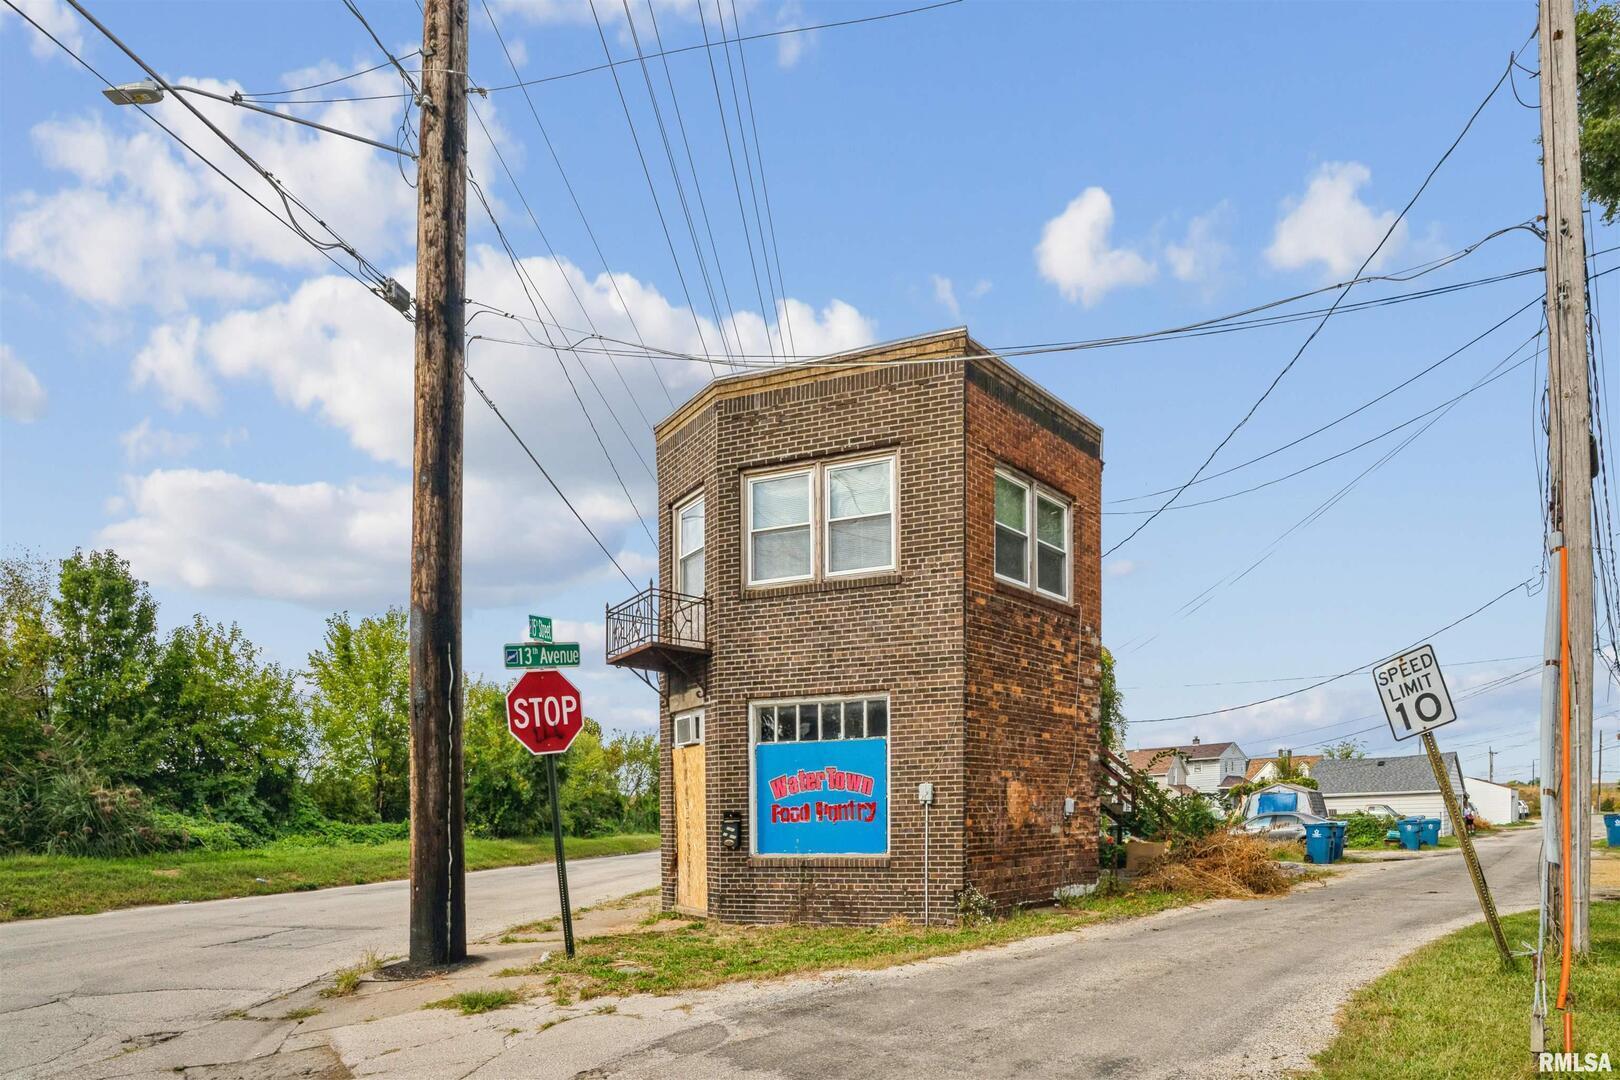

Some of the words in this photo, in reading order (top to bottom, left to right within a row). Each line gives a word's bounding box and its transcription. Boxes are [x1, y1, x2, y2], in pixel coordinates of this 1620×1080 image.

[538, 618, 552, 640] Street
[518, 647, 539, 665] 13th
[540, 647, 579, 664] Avenue
[1378, 653, 1433, 686] SPEED
[1388, 672, 1432, 702] LIMIT
[513, 695, 577, 729] STOP
[1395, 692, 1442, 731] 10
[771, 803, 811, 824] Food
